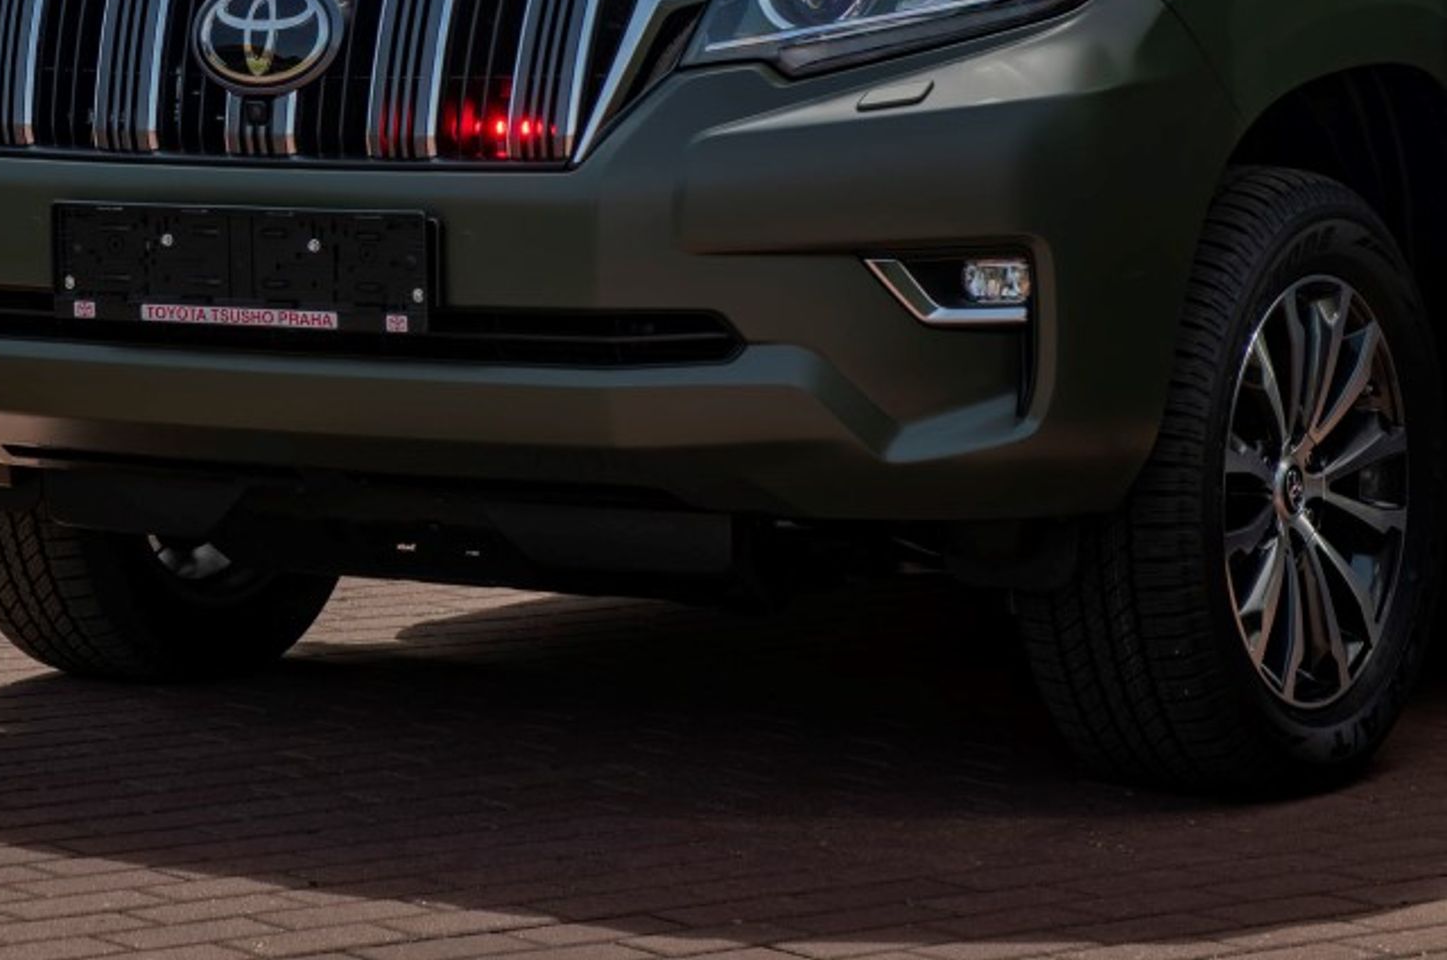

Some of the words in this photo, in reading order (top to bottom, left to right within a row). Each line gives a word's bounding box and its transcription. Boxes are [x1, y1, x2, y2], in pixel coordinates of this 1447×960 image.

[146, 306, 207, 322] TOYOTA
[211, 309, 274, 324] TSUSHO
[278, 311, 333, 327] PRAHA
